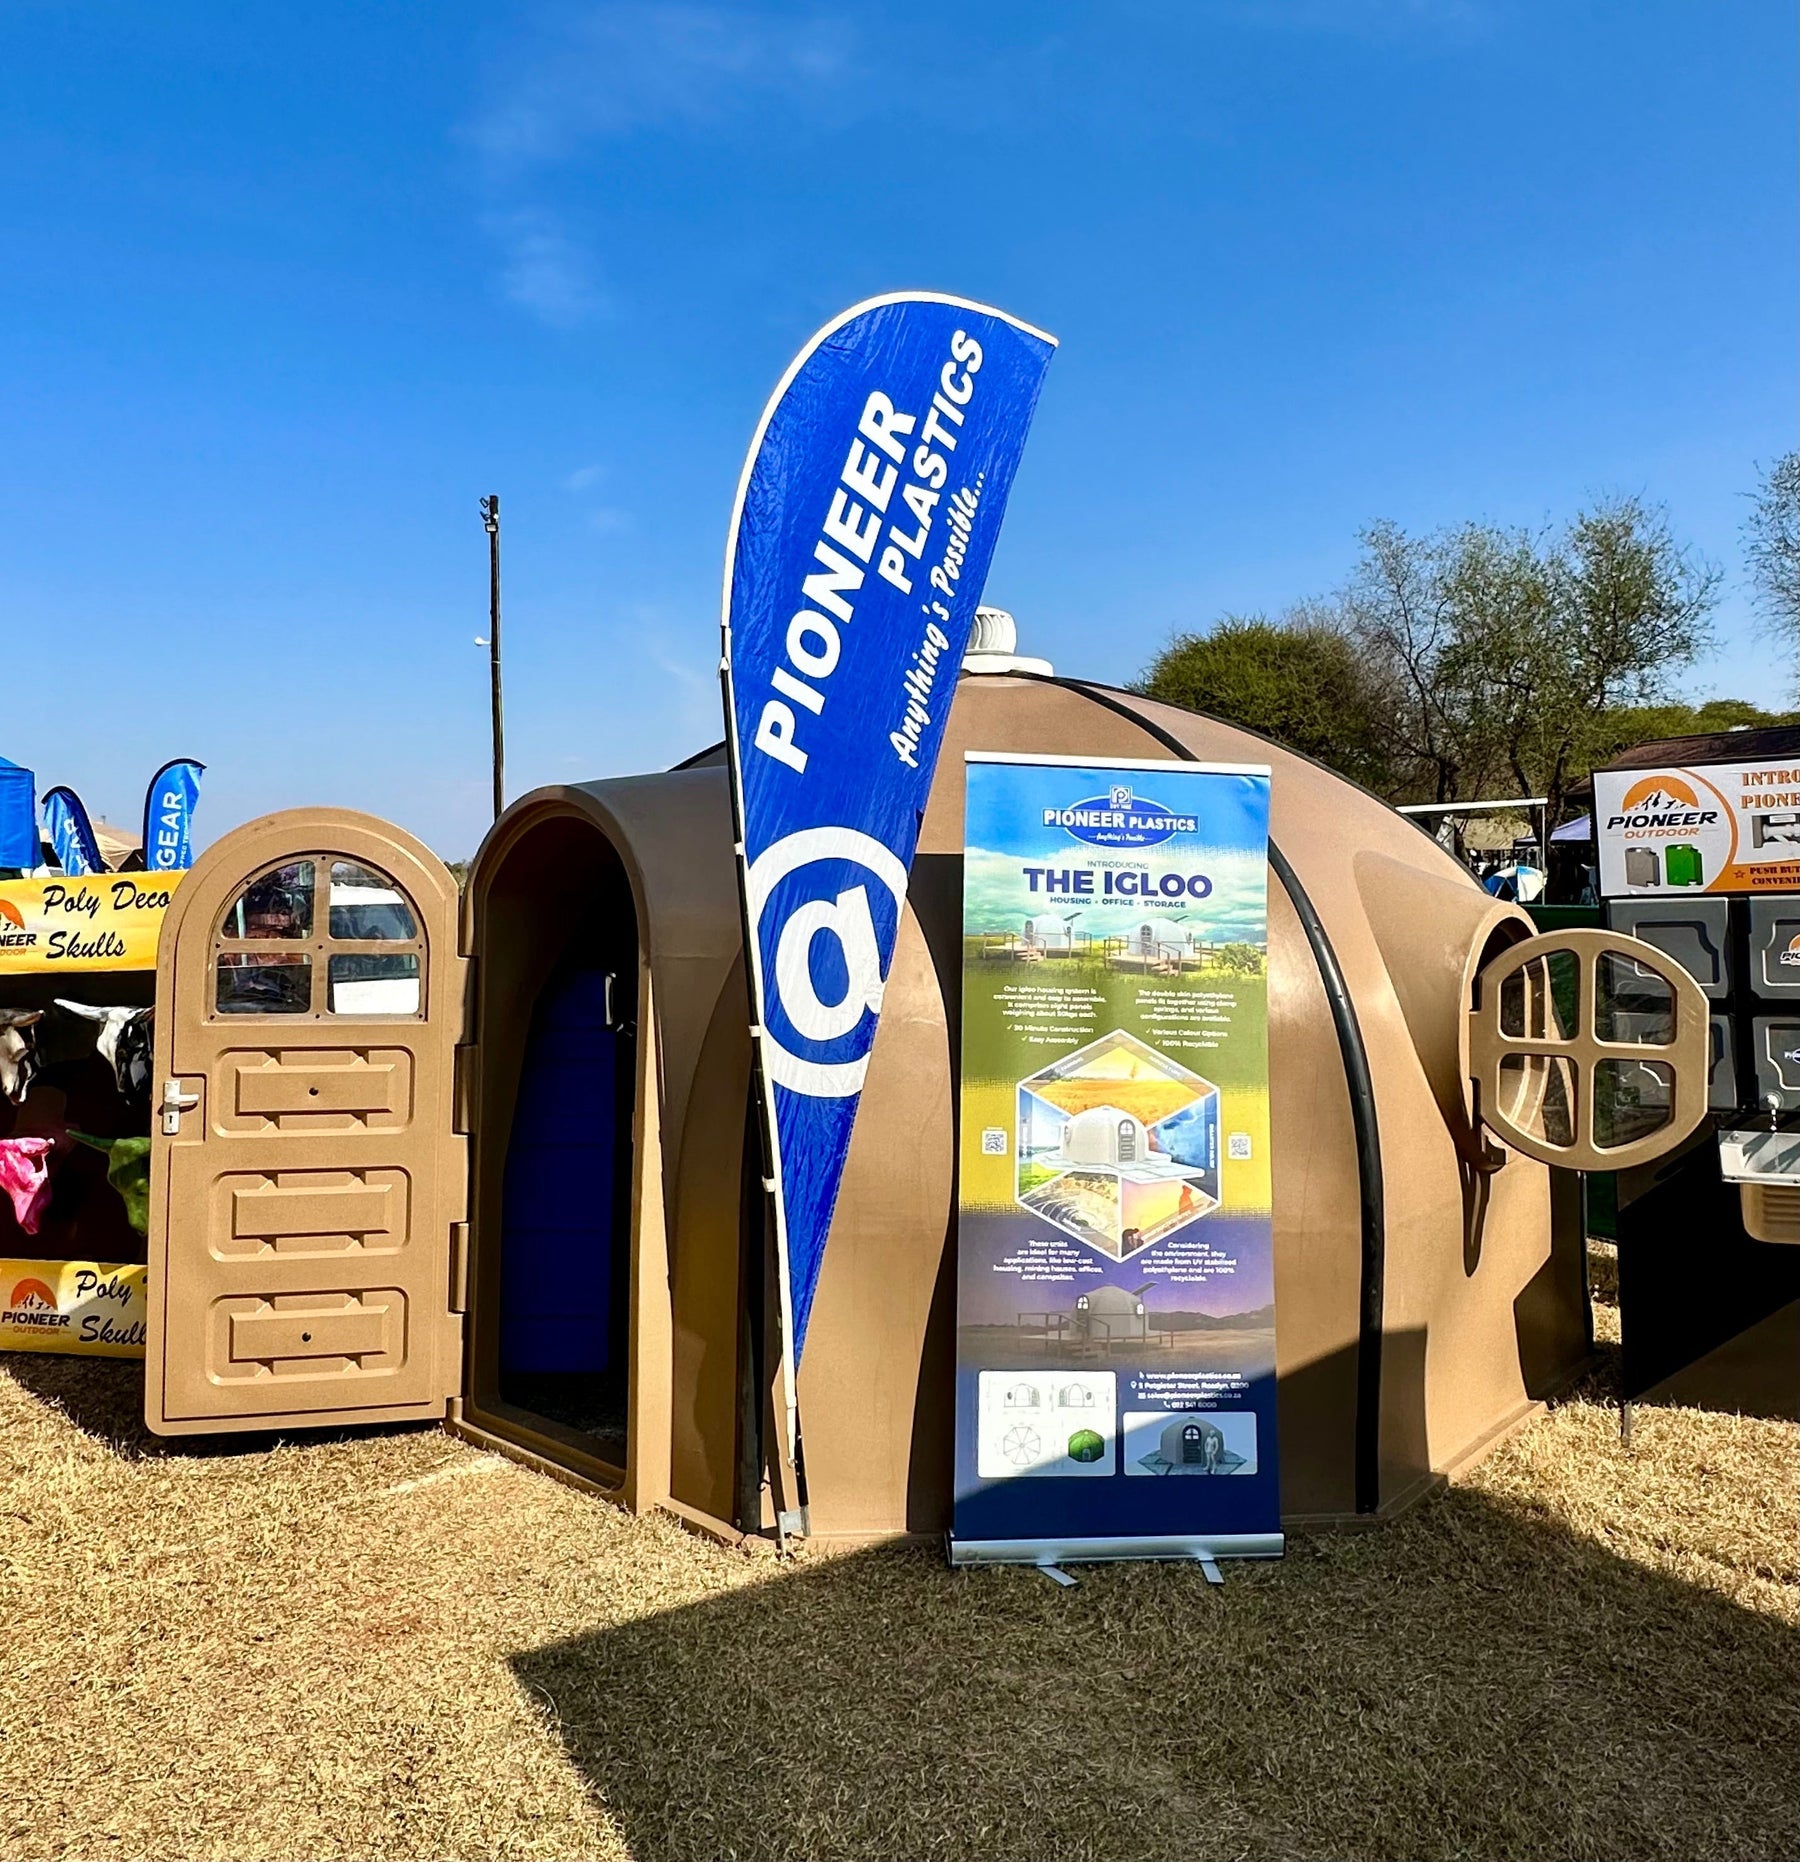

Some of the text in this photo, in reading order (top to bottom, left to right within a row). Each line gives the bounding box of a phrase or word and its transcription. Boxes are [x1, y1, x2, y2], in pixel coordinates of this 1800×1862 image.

[877, 329, 984, 595] PLASTICS
[754, 390, 918, 774] PIONEER
[889, 472, 986, 768] Anything's Possible...
[1742, 769, 1800, 786] INTRO
[1741, 792, 1800, 809] PIONE
[1044, 809, 1196, 832] PIONEER PLASTICS
[1606, 811, 1718, 830] PIONEER
[156, 791, 184, 870] GEAR
[1623, 828, 1700, 840] OUTDOOR
[1087, 860, 1150, 870] INTRODUCING
[1750, 866, 1777, 874] PUSH
[1023, 868, 1212, 899] THE IGLOO
[43, 885, 102, 919] Poly
[1050, 896, 1186, 908] HOUSING OFFICE STORAGE
[46, 931, 126, 959] Skulls
[1168, 1242, 1209, 1250] Considering
[75, 1270, 133, 1307] Poly
[1, 1311, 71, 1327] PIONEER
[13, 1326, 60, 1335] OUTDOOR
